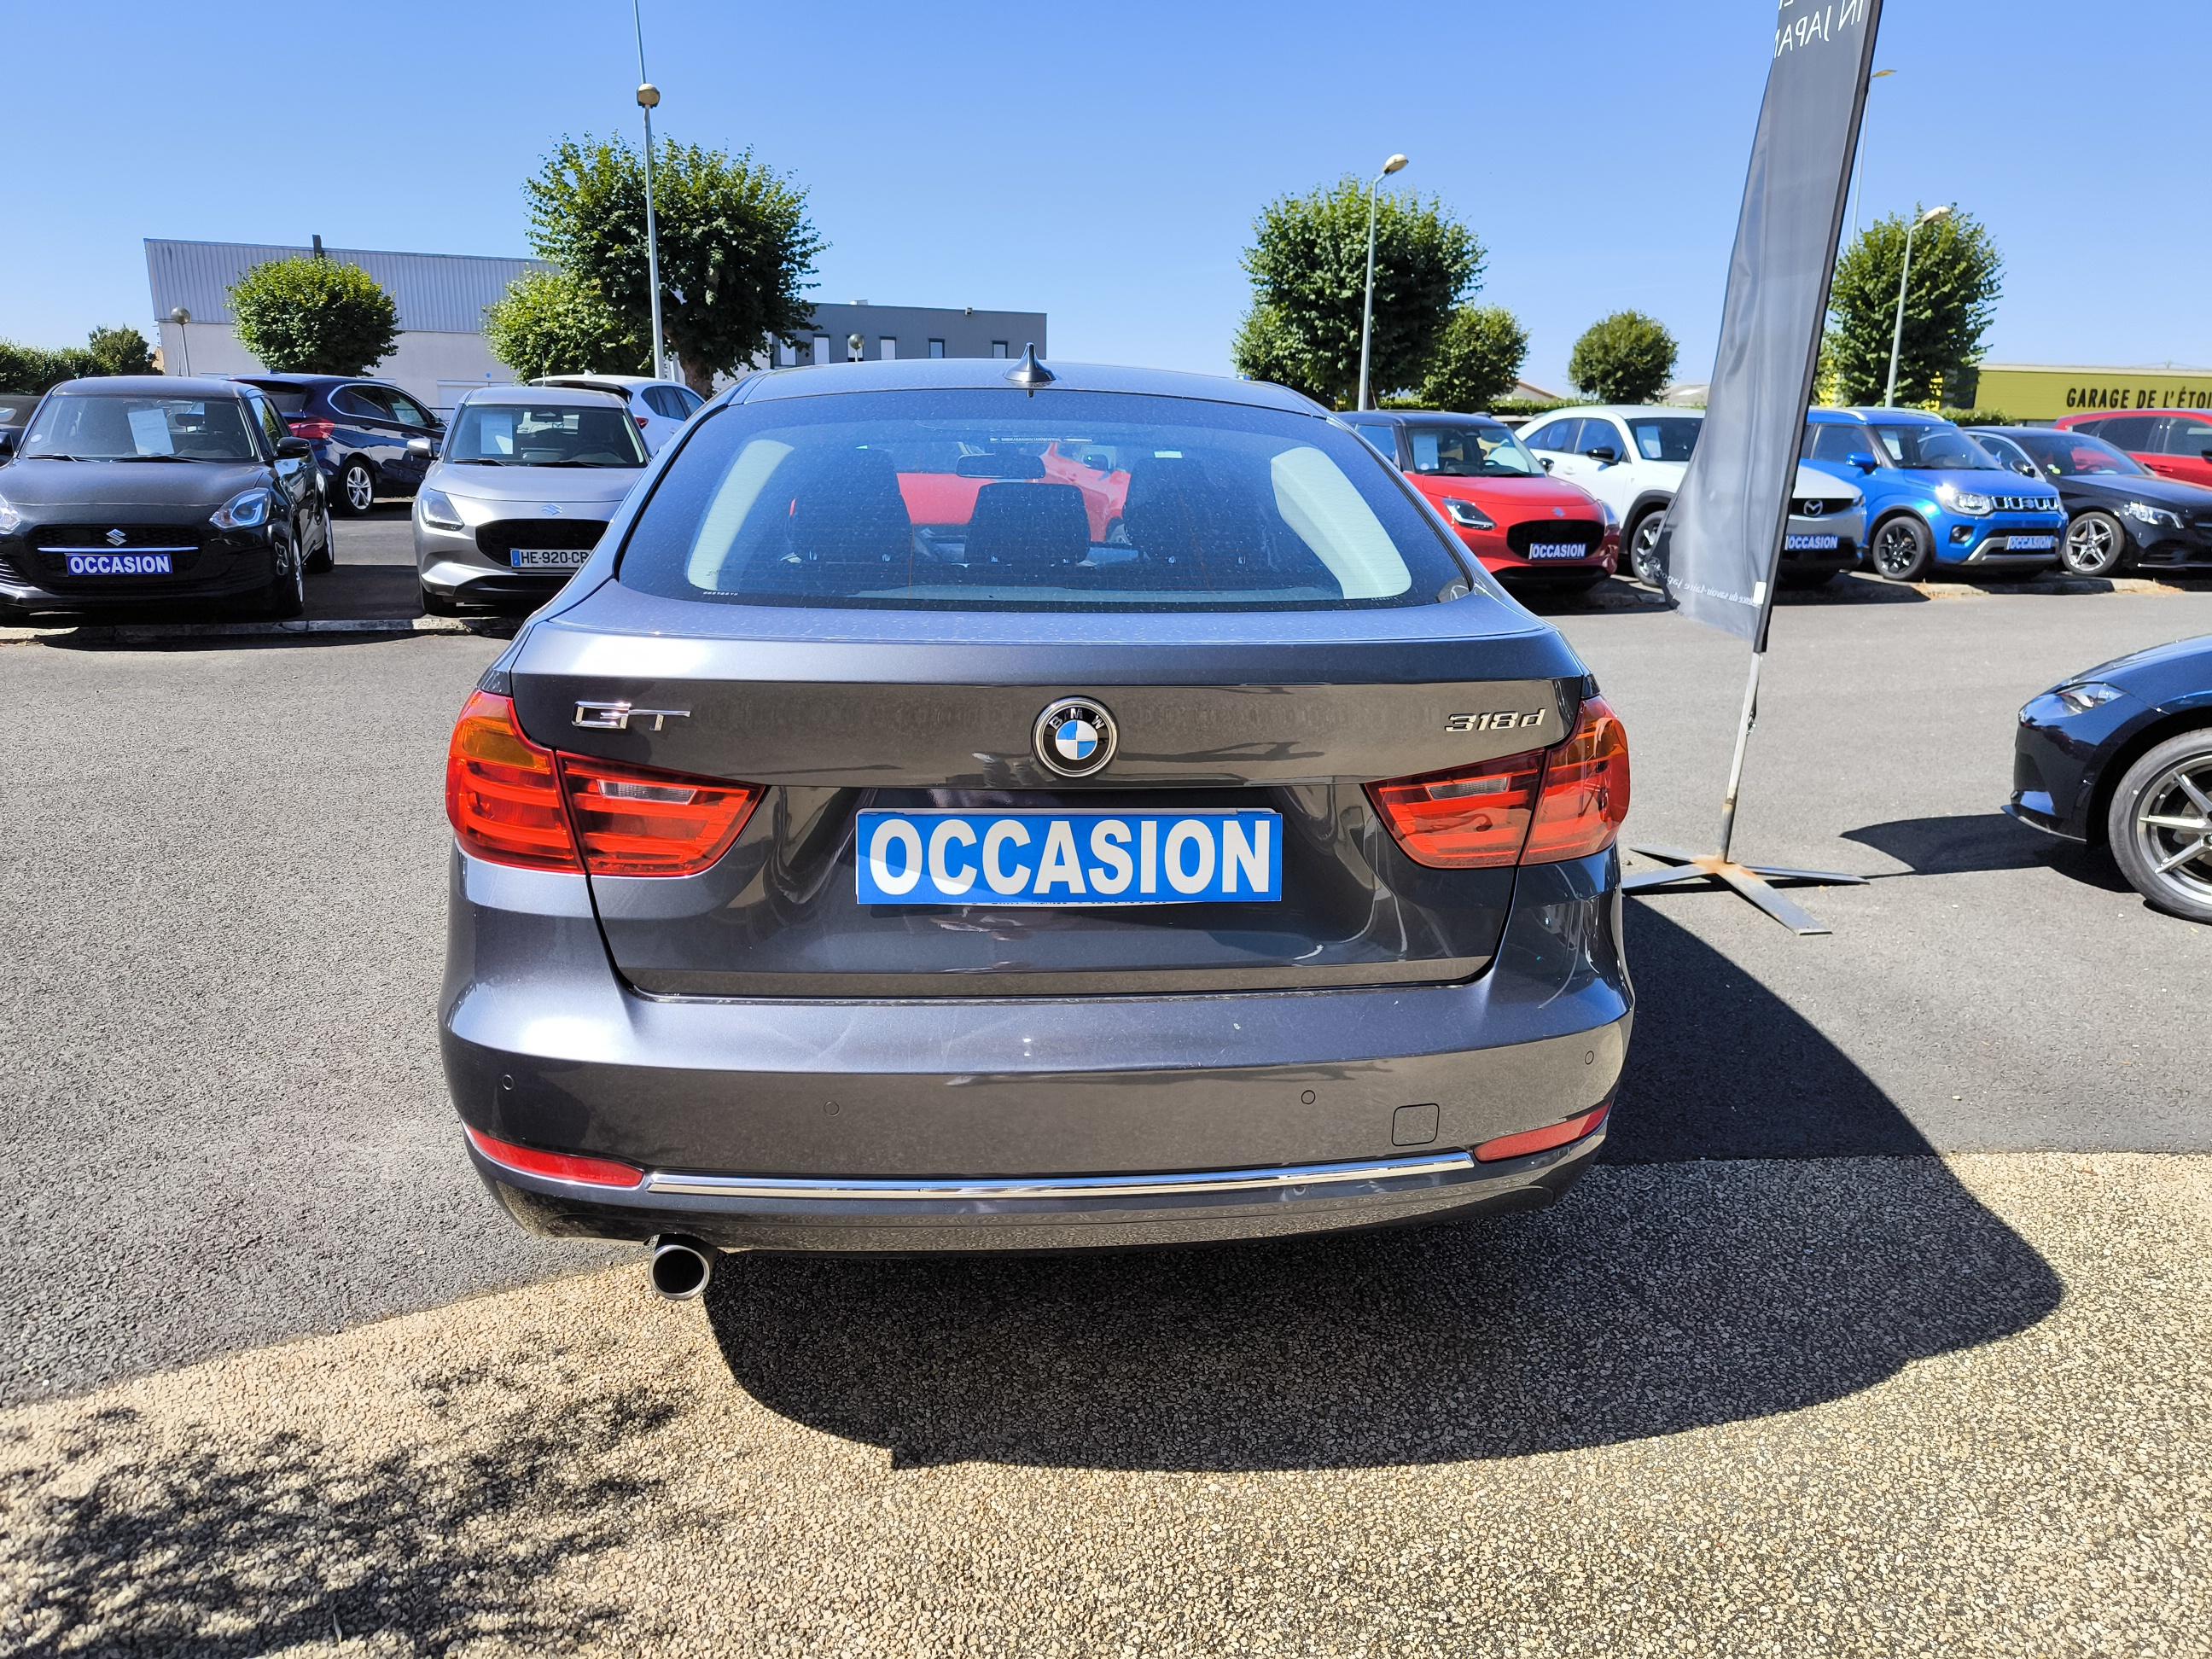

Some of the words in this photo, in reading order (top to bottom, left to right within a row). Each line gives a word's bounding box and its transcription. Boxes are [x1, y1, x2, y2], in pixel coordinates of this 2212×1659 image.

[2066, 387, 2130, 409] GARAGE
[2136, 389, 2157, 409] DE
[1532, 544, 1586, 558] OCCASION
[1788, 536, 1837, 549] OCCASION
[2010, 537, 2052, 549] OCCASION
[70, 556, 170, 573] OCCASION
[571, 701, 690, 731] GT
[1049, 708, 1105, 730] BMW
[1445, 707, 1546, 732] 318d
[869, 818, 1270, 895] OCCASION
